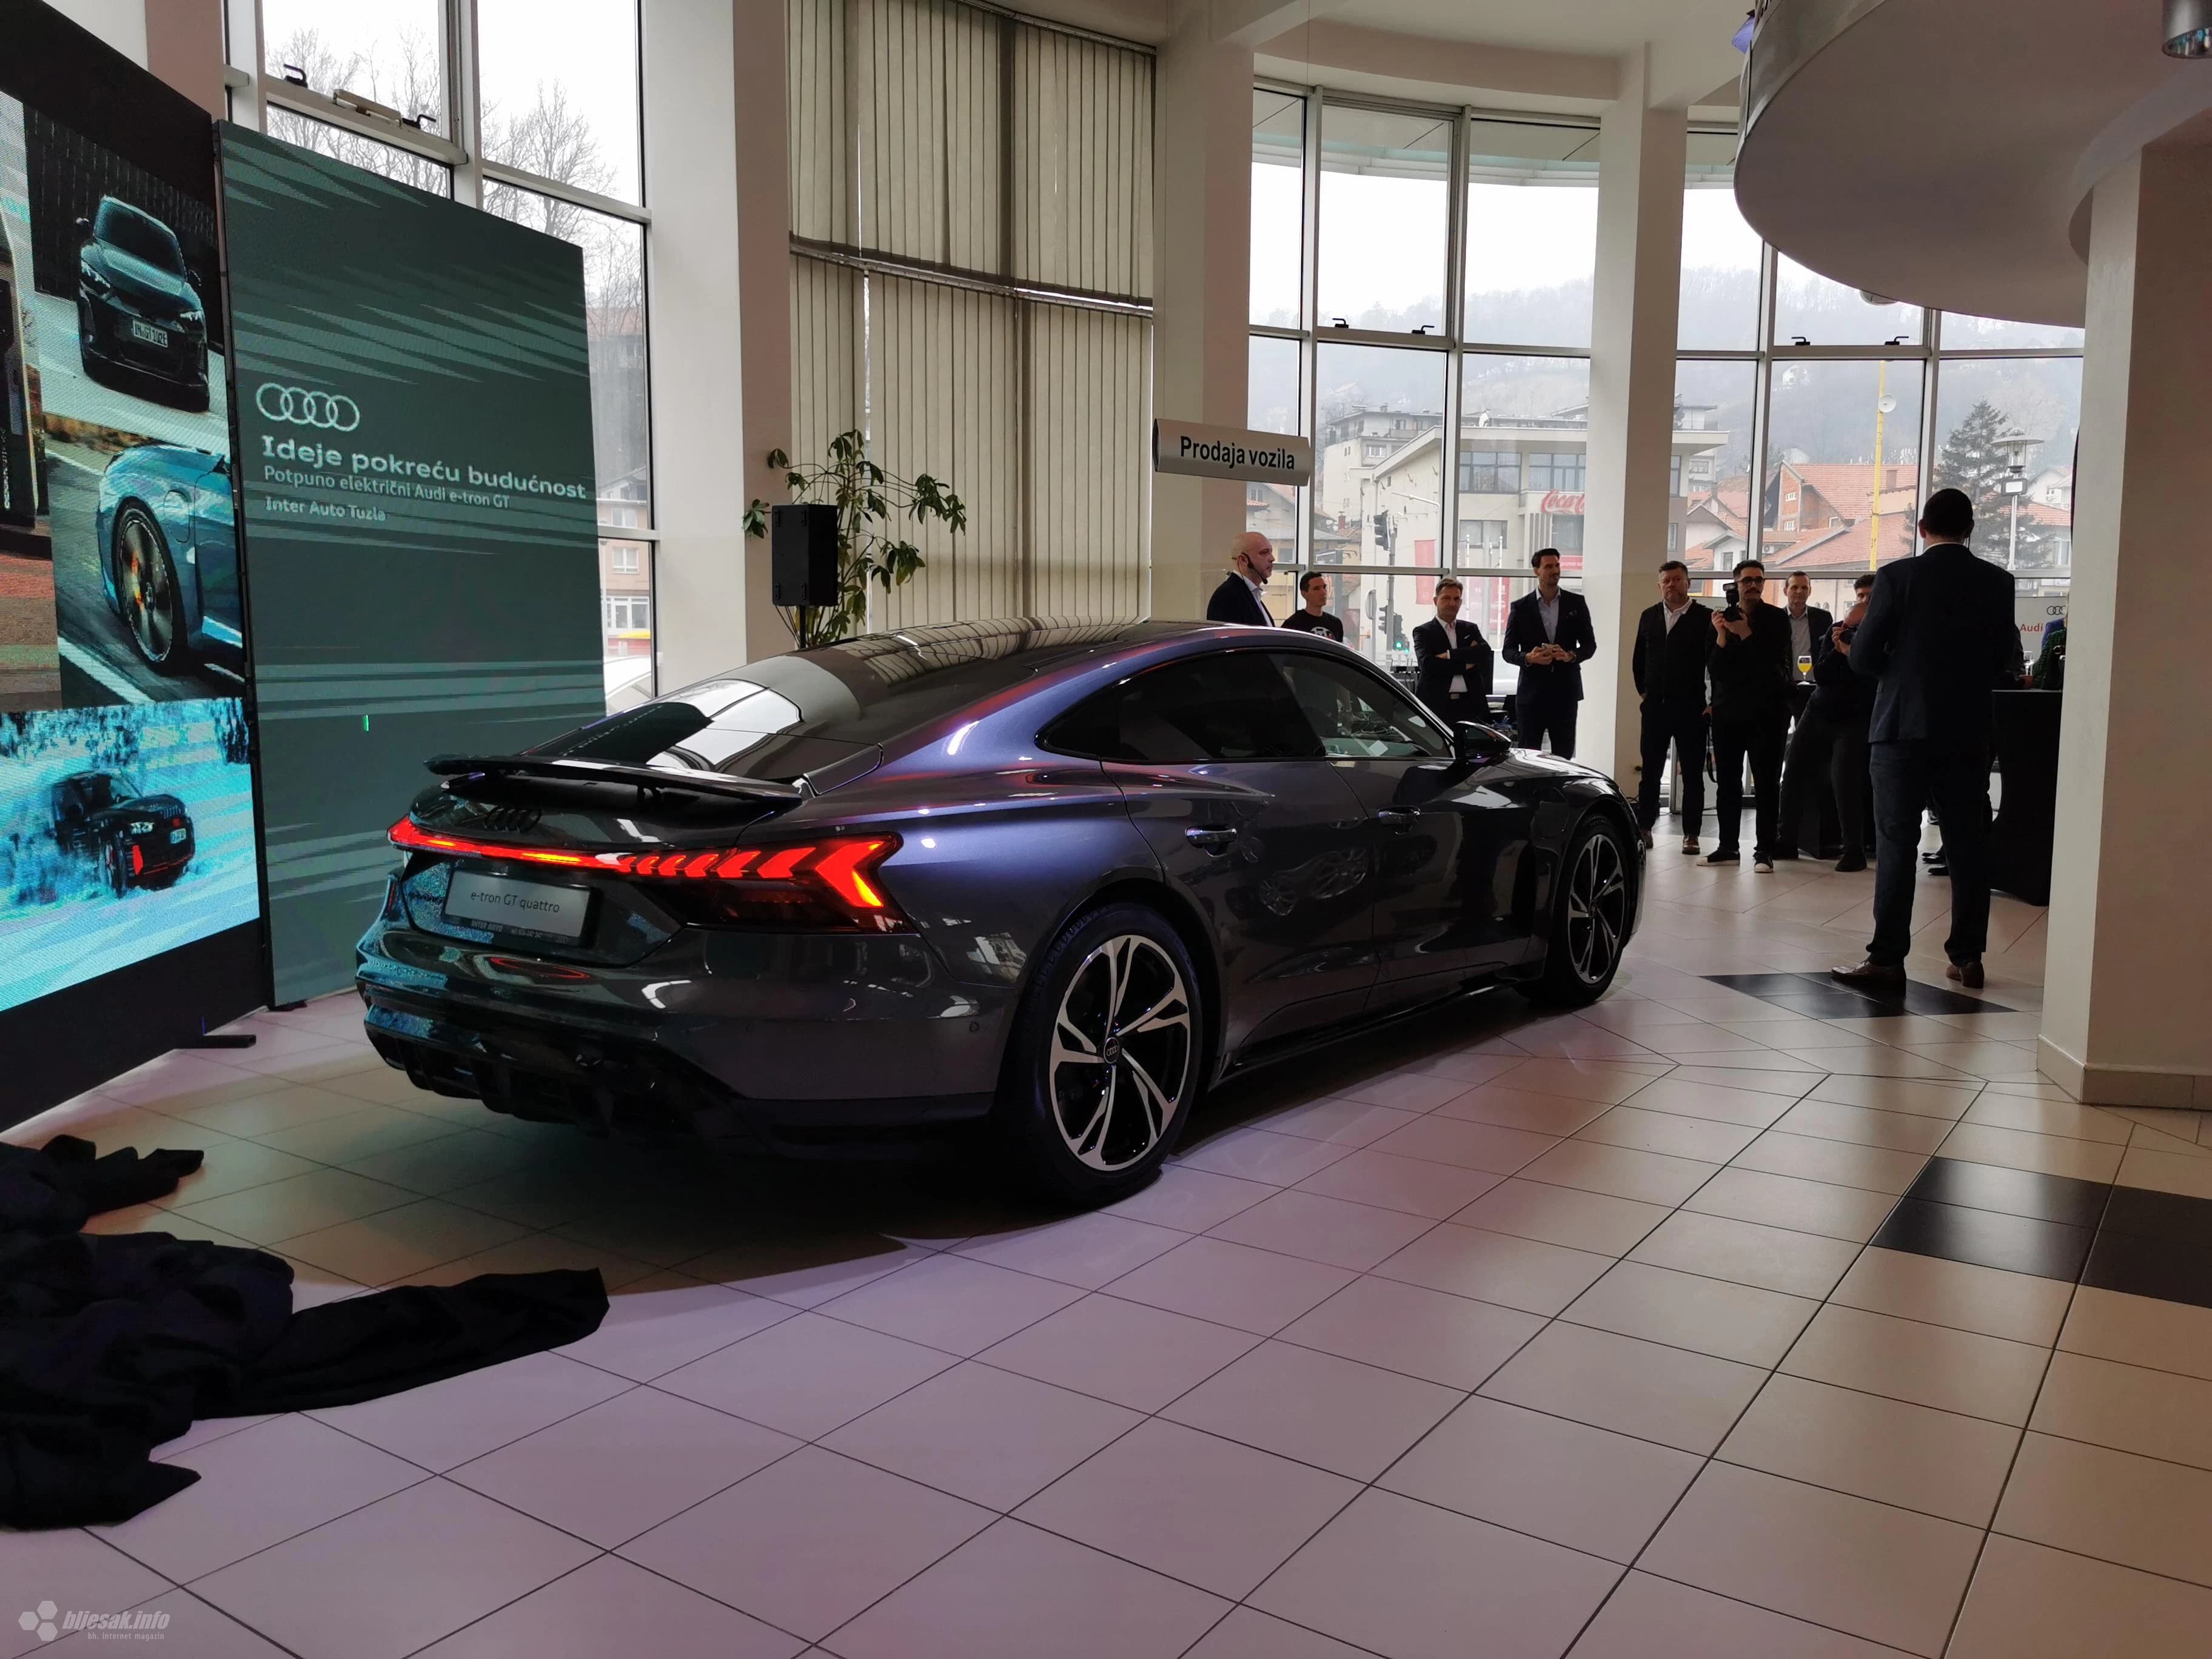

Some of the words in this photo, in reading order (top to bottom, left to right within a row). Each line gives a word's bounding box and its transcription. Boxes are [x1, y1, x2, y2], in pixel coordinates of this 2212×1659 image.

[1180, 435, 1244, 469] Prodaja
[1248, 448, 1295, 470] vozila
[261, 435, 342, 469] Ideje
[352, 454, 460, 483] pokreću
[468, 466, 587, 500] budućnost
[264, 465, 335, 489] Potpuno
[340, 475, 411, 497] električni
[415, 483, 446, 501] Audi
[449, 491, 490, 507] e-tron
[493, 494, 509, 509] GT
[265, 495, 304, 513] Inter
[309, 501, 346, 518] Auto
[348, 504, 386, 521] Tuzla
[1541, 489, 1584, 514] Coca-C
[2020, 623, 2043, 632] Audi
[470, 891, 501, 903] e-tron
[503, 894, 518, 906] GT
[520, 898, 560, 913] quattro
